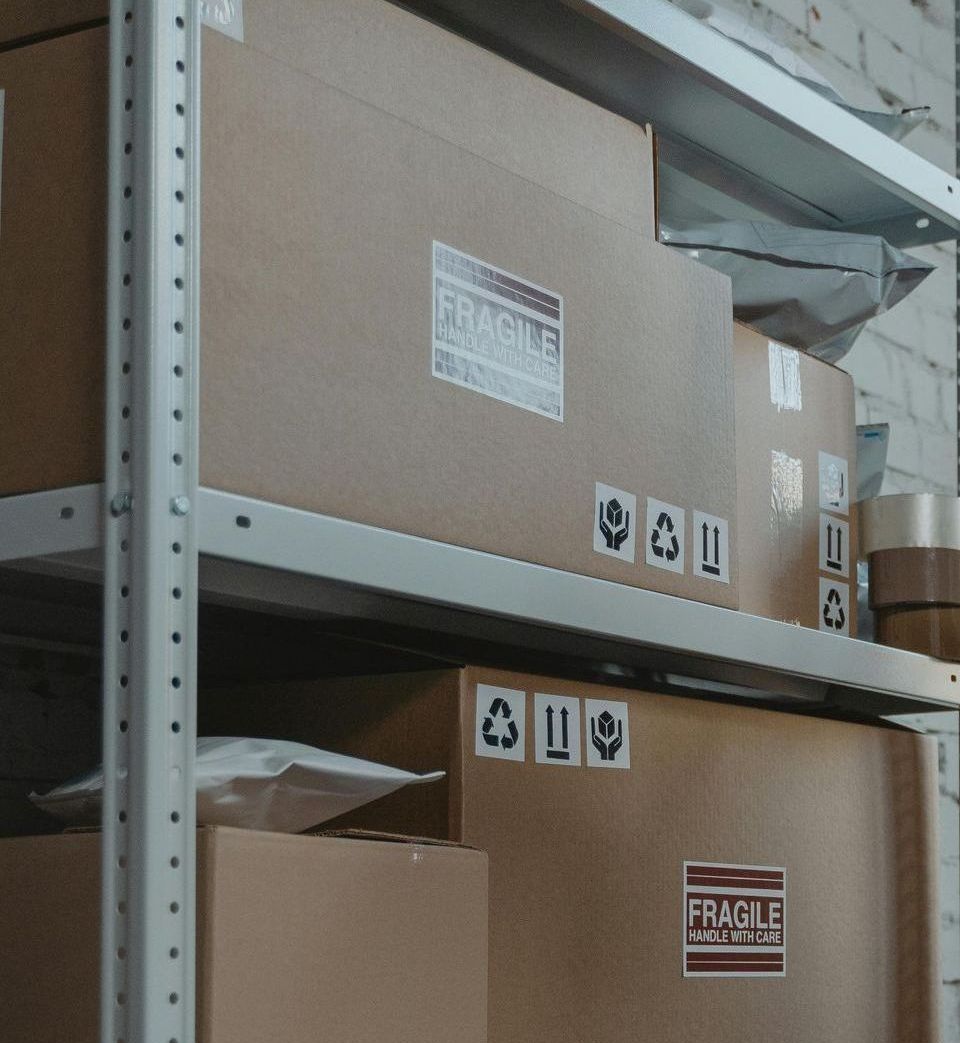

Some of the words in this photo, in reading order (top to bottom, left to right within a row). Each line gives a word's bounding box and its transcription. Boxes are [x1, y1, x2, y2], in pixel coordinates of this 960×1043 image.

[439, 287, 557, 363] FRAGILE
[439, 324, 491, 354] HANDLE
[494, 345, 522, 367] WITH
[526, 355, 559, 383] CARE
[688, 899, 781, 929] FRAGILE
[688, 929, 729, 942] HANDLE
[731, 930, 754, 943] WITH
[756, 931, 781, 943] CARE
